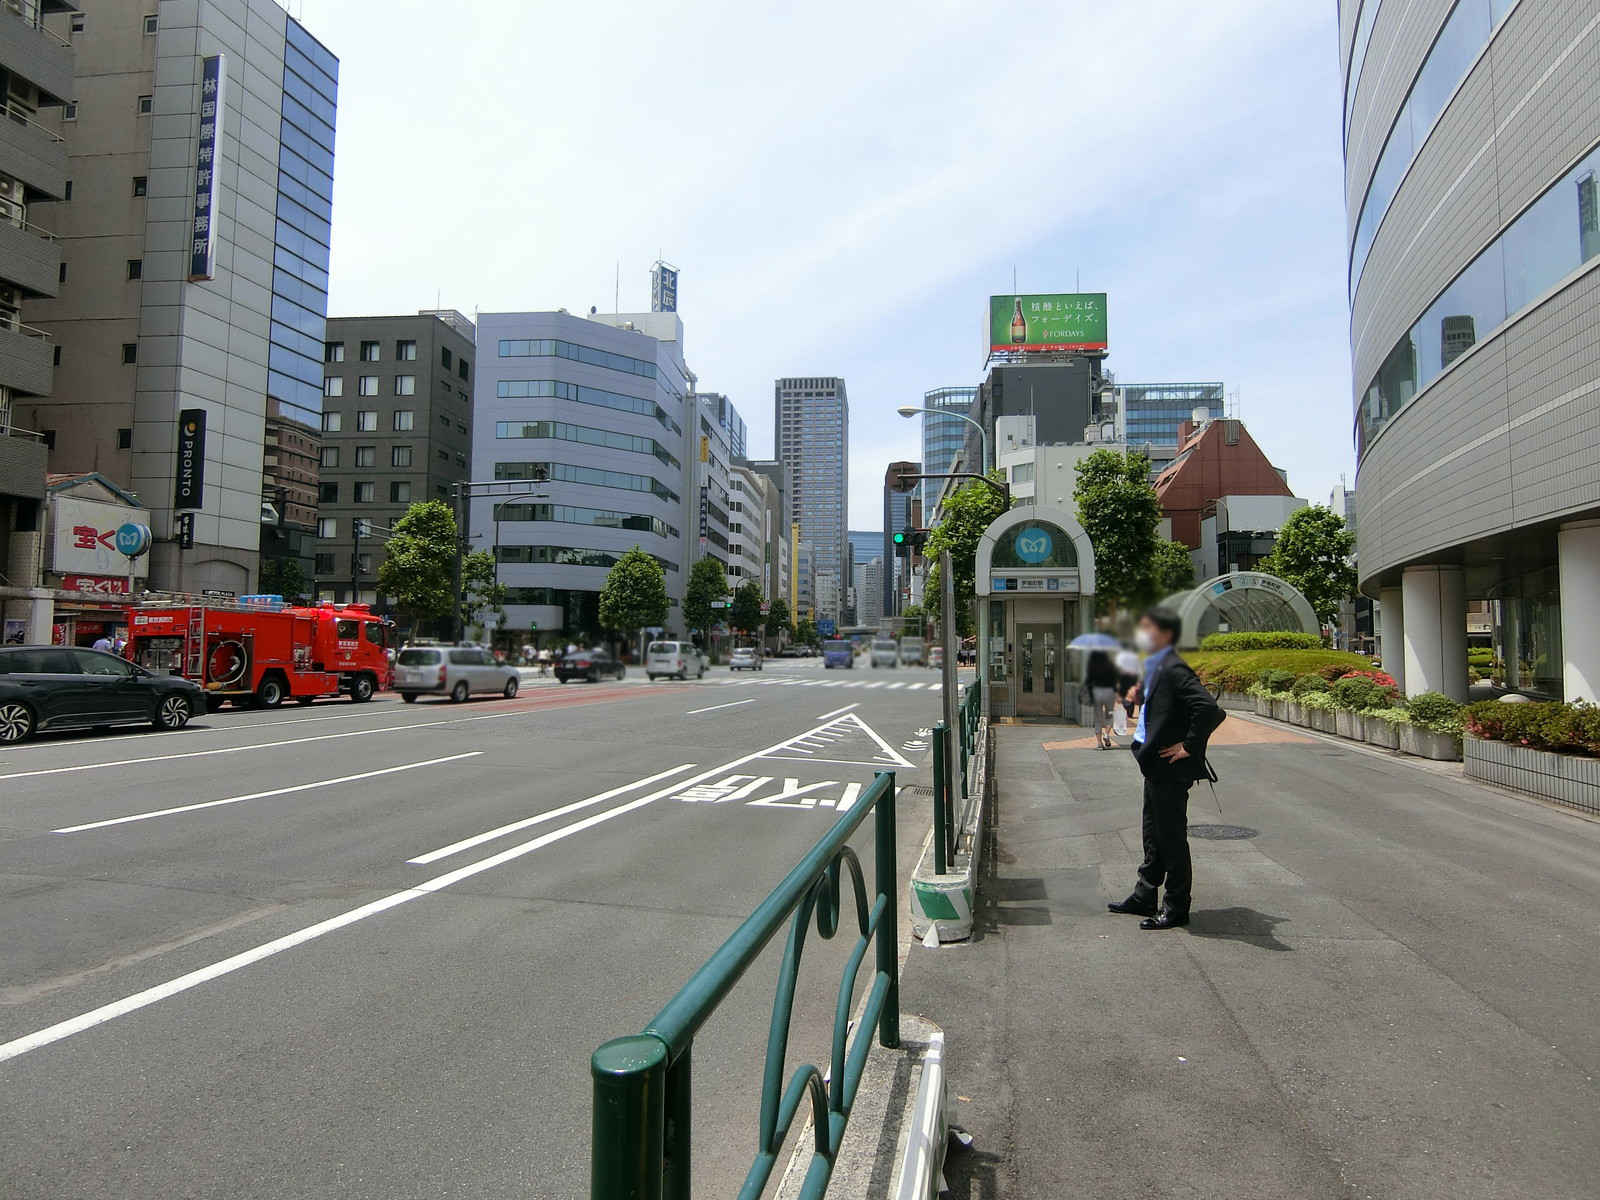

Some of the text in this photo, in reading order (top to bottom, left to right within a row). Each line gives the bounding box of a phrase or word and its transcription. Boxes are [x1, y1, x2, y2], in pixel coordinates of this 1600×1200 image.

[193, 78, 217, 255] 林国際特許事務所
[662, 271, 675, 312] 北辰
[1030, 301, 1098, 312] 核酸といえば、
[1031, 313, 1098, 323] フォーデイズ。
[1049, 330, 1085, 338] FORDAYS
[182, 440, 193, 497] PRONTO
[73, 525, 116, 551] 宝く
[76, 578, 123, 593] 宝くじ
